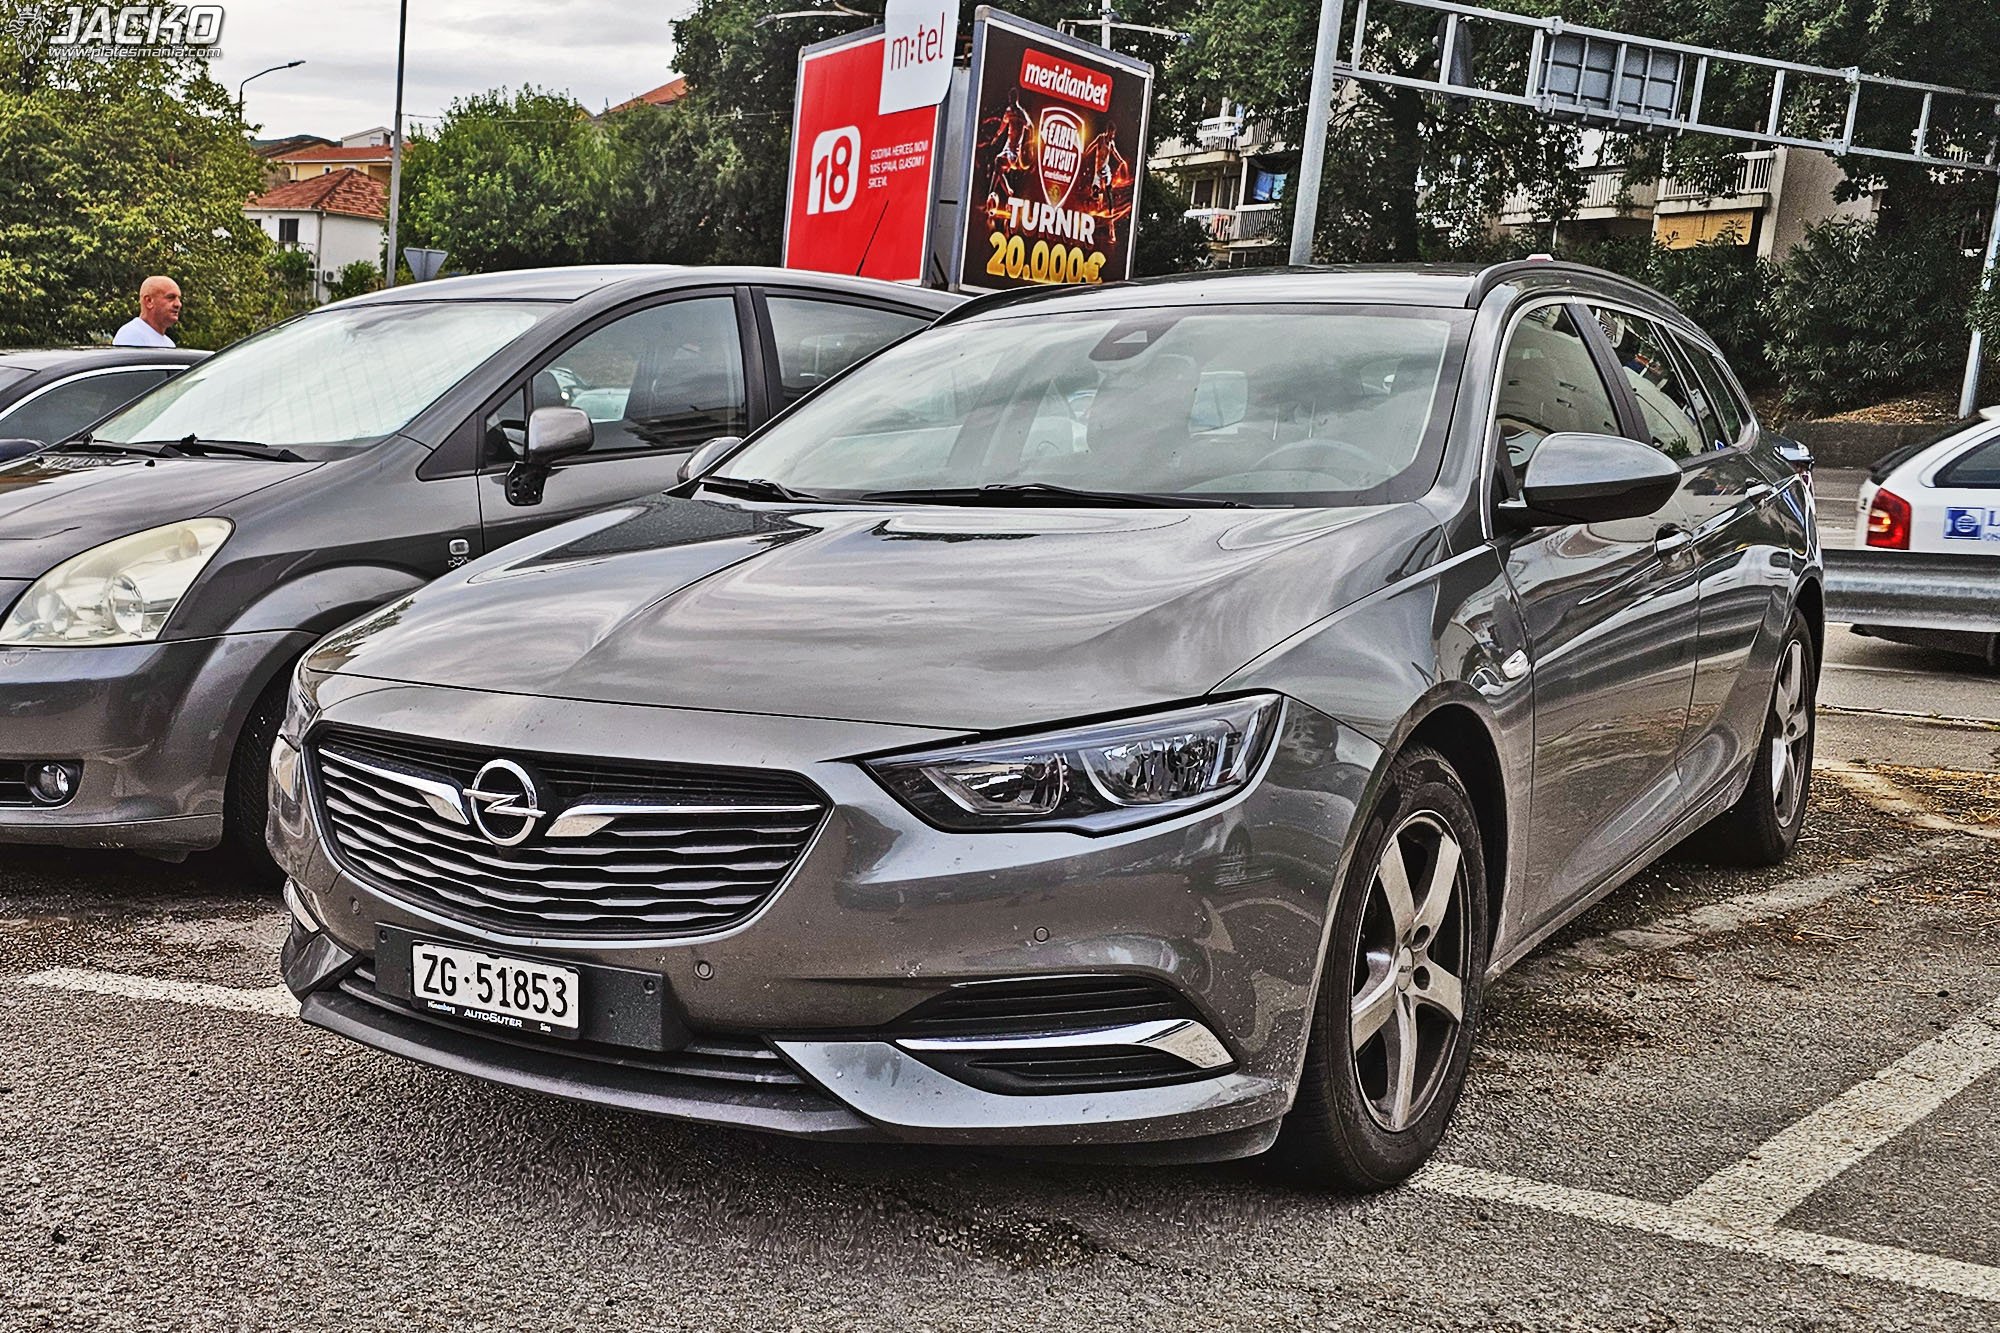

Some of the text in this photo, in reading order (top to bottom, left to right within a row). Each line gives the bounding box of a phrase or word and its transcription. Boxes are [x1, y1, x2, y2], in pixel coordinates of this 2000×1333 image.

[890, 12, 945, 71] m:tel
[1024, 62, 1108, 106] meridianbet
[815, 135, 852, 213] 18
[1007, 196, 1096, 245] TURNIR
[986, 231, 1107, 284] 20.000€
[422, 953, 568, 1018] ZG 51853
